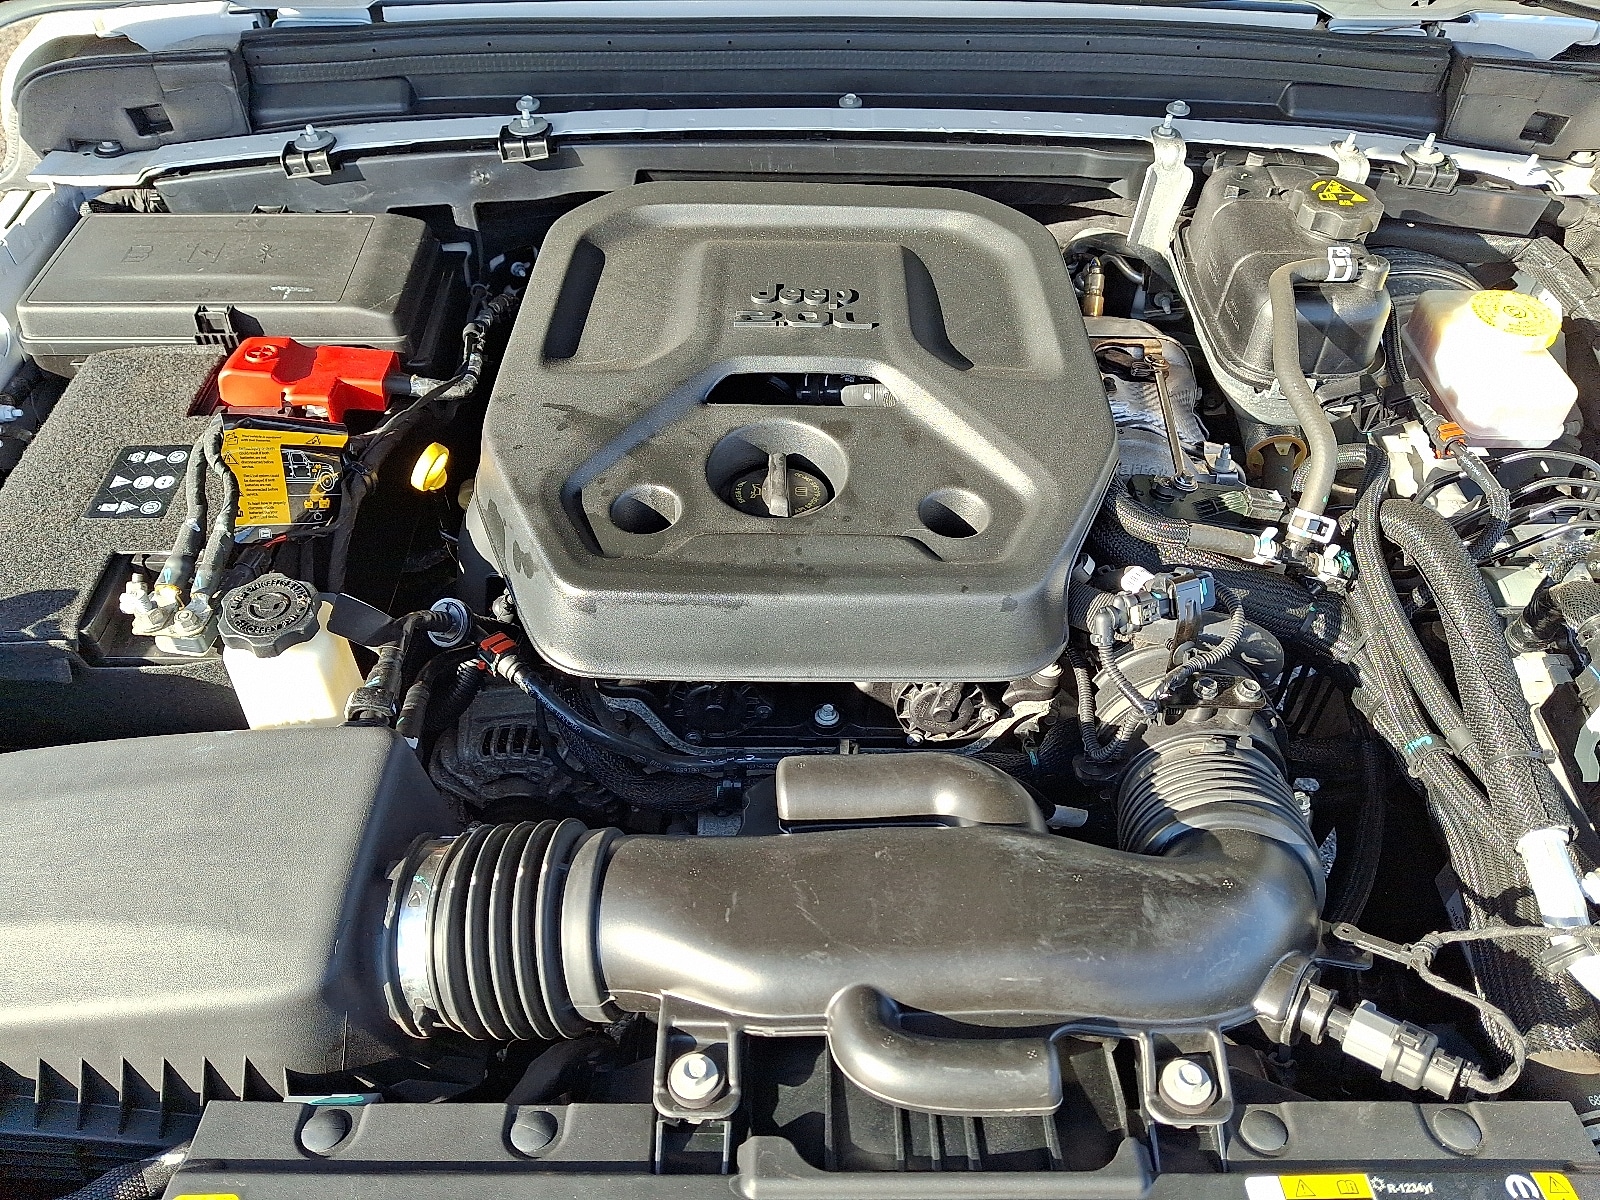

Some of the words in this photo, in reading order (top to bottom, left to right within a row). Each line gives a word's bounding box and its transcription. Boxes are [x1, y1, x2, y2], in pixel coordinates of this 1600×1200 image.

[750, 280, 860, 310] Jeep
[733, 309, 879, 329] 2.0L
[1588, 1094, 1600, 1107] 68
[1386, 1182, 1435, 1195] R-1234yf
